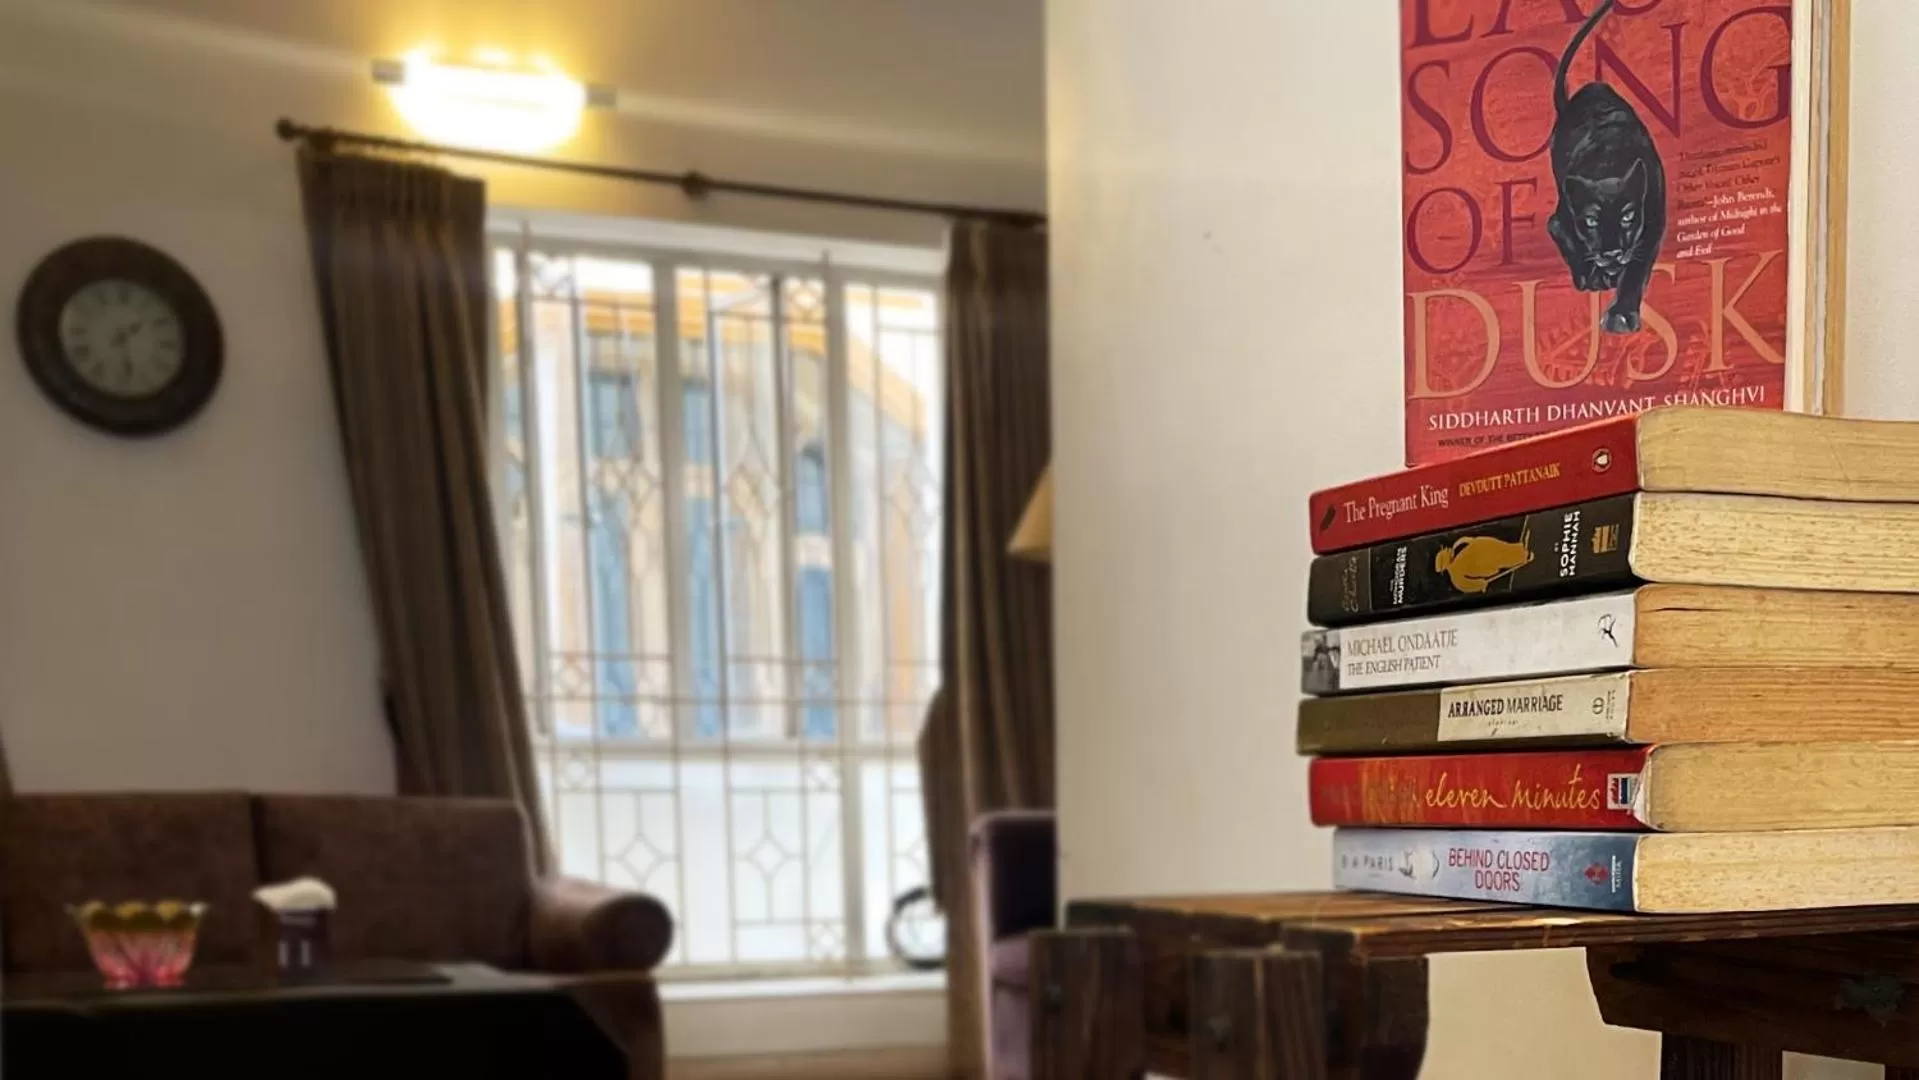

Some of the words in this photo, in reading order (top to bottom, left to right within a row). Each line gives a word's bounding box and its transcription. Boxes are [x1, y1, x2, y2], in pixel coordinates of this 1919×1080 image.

[1405, 6, 1791, 174] SONG
[1406, 178, 1540, 274] OF
[1708, 212, 1718, 222] of
[1720, 206, 1758, 219] Midnight
[1760, 207, 1768, 215] in
[1770, 202, 1782, 213] the
[1676, 246, 1693, 258] and
[1695, 242, 1712, 256] Evil
[1677, 229, 1709, 243] Garden
[1711, 227, 1720, 240] of
[1721, 223, 1745, 236] Good
[1406, 249, 1785, 400] DUSK
[1429, 407, 1539, 430] SIDDHARTH
[1547, 397, 1656, 421] DHANVANT
[1664, 385, 1764, 406] SHANGHVI
[1459, 475, 1502, 497] DEVDUTT
[1503, 463, 1560, 487] PATTANAIK
[1344, 500, 1365, 522] The
[1368, 494, 1418, 520] Pregnant
[1420, 484, 1449, 508] King
[1560, 512, 1573, 577] SOPHIE
[1569, 511, 1580, 576] HANNAH
[1346, 636, 1395, 656] MICHAEL
[1397, 628, 1459, 652] ONDAATJE
[1347, 662, 1363, 676] THE
[1366, 658, 1402, 675] ENGLISH
[1404, 655, 1441, 672] PATIENT
[1448, 698, 1503, 718] ARRANGED
[1506, 694, 1563, 713] MARRIAGE
[1425, 771, 1507, 808] eleven
[1448, 848, 1492, 867] BEHIND
[1497, 850, 1550, 871] CLOSED
[1475, 869, 1521, 891] DOORS
